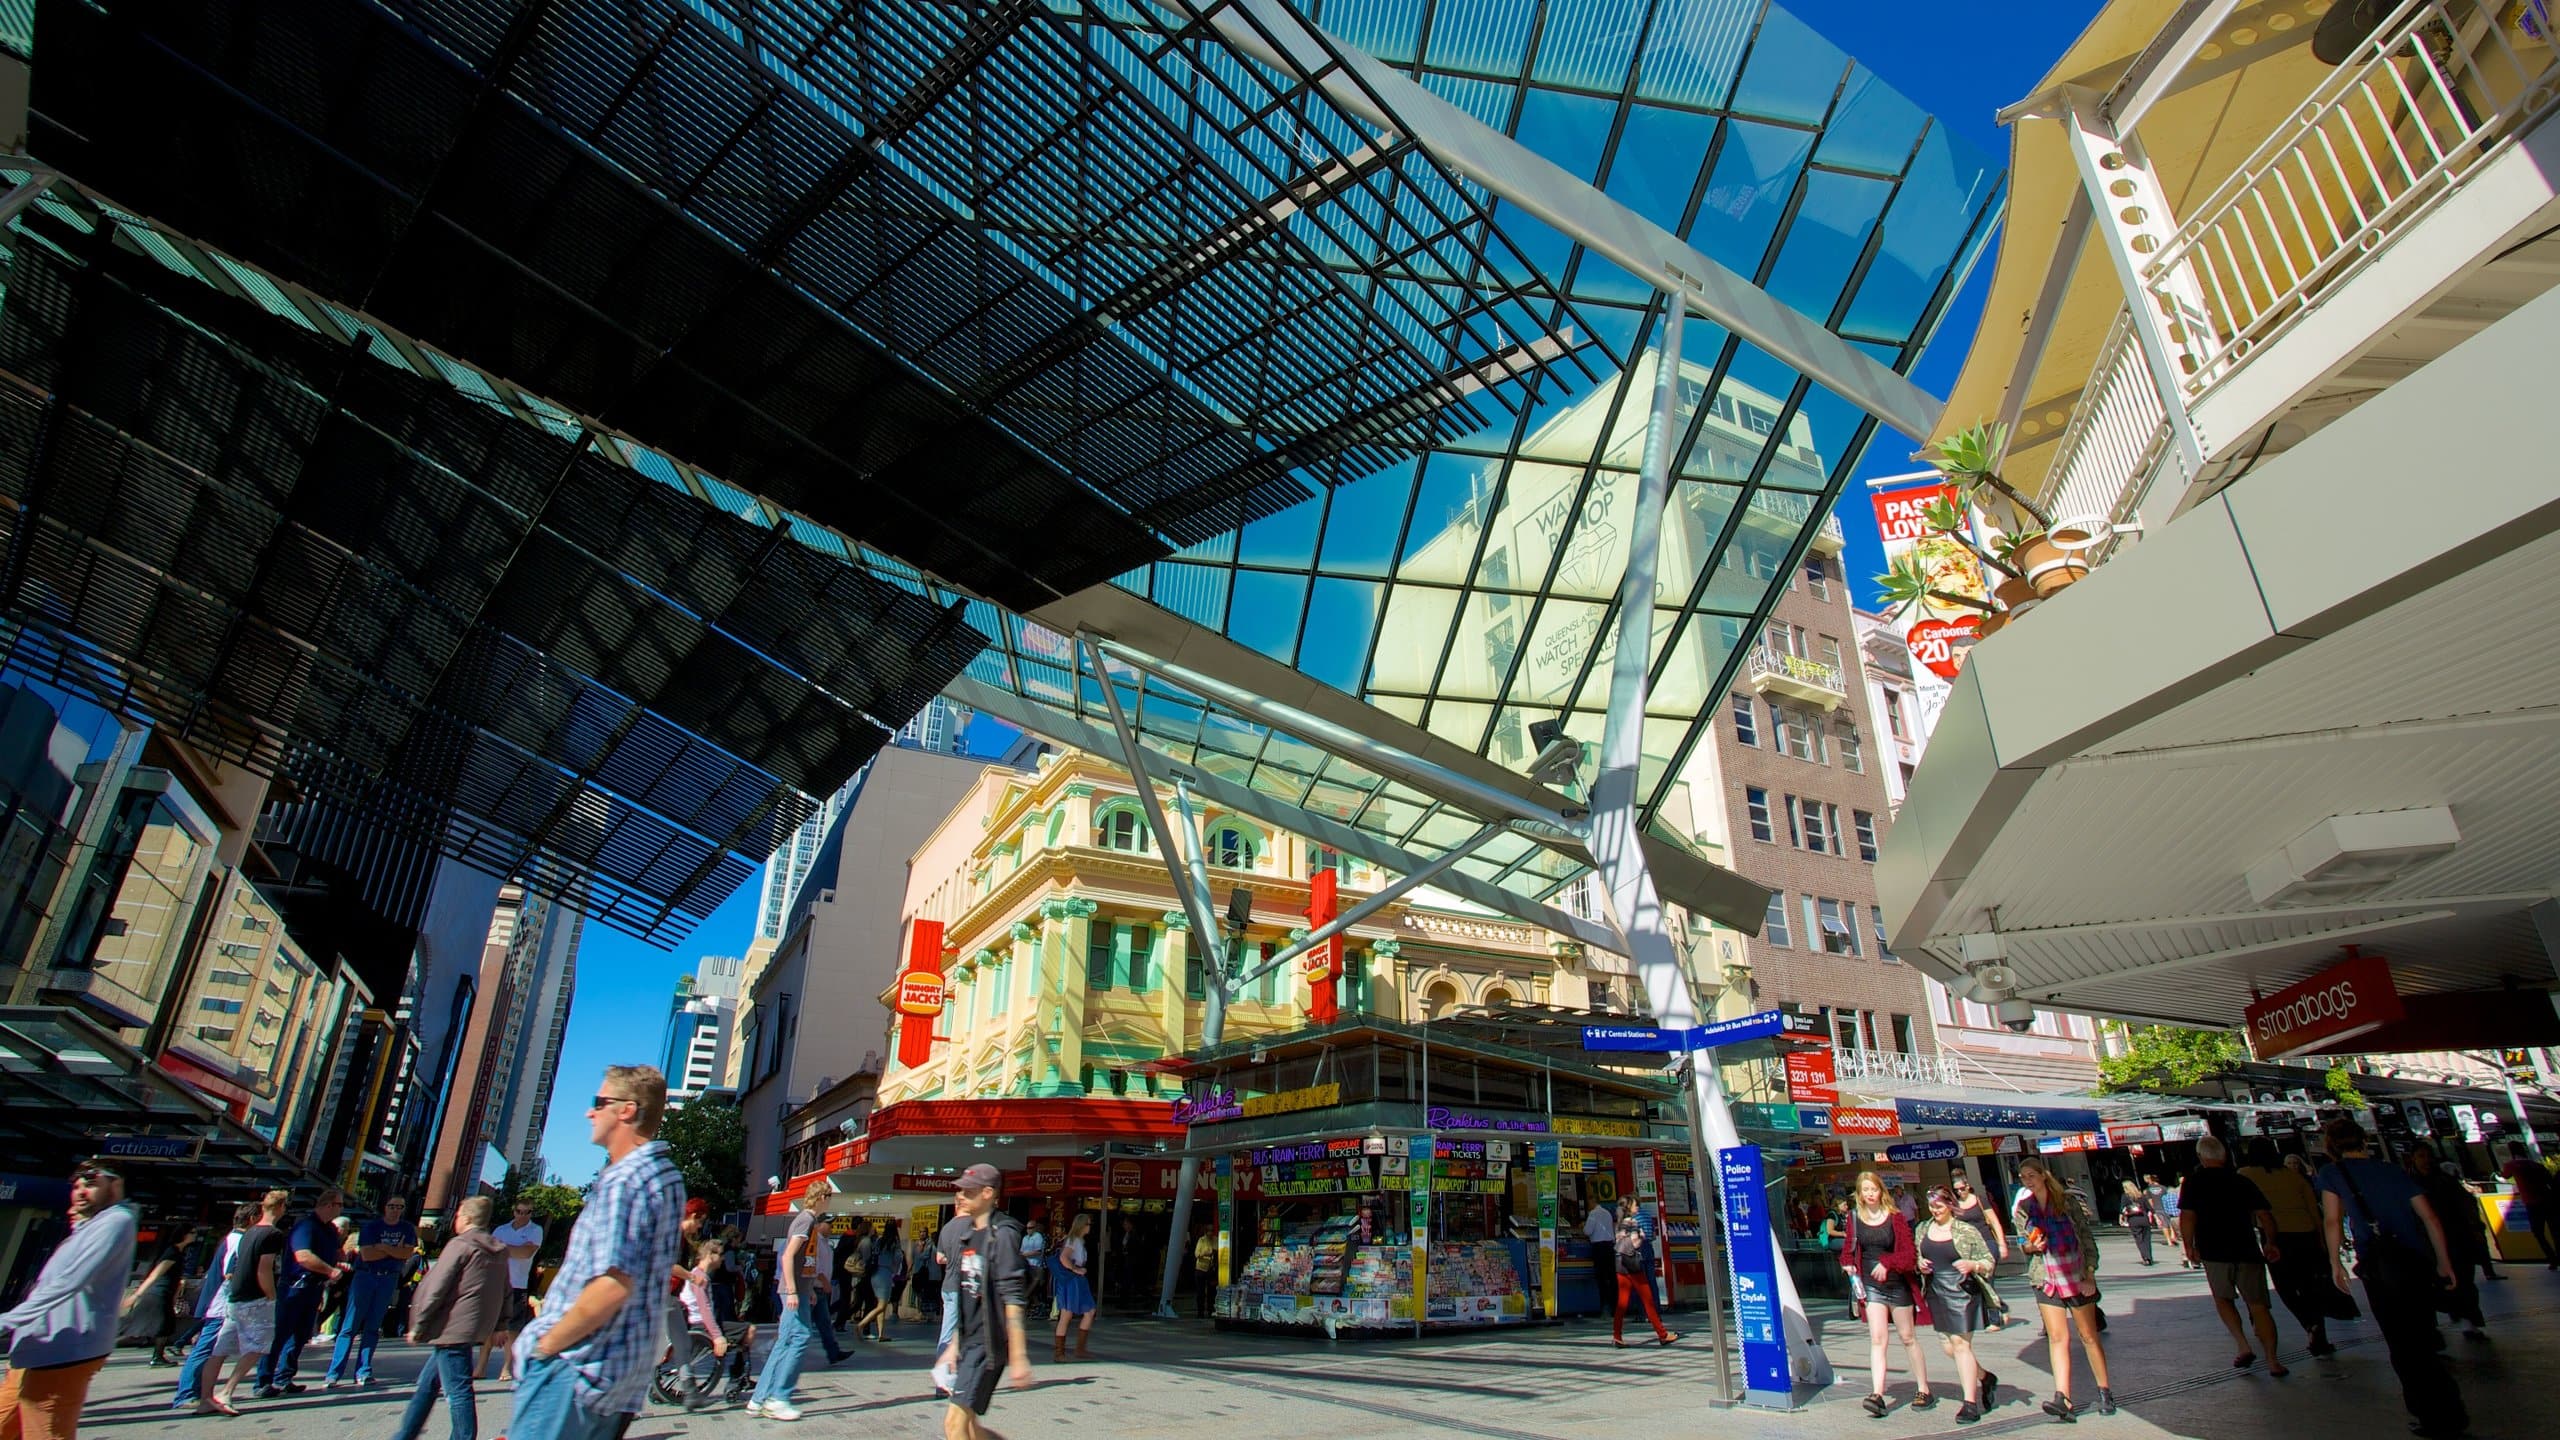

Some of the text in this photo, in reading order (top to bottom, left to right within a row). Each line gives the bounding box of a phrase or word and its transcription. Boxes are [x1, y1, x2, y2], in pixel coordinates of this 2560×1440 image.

[1536, 634, 1578, 670] WATCH
[1909, 638, 1950, 664] $20
[1307, 944, 1328, 960] HUNGRY
[904, 983, 941, 994] HUNGRY
[904, 992, 941, 1005] JACK'S
[2257, 981, 2357, 1041] strandbags
[1705, 1025, 1726, 1035] Adelaide
[1726, 1023, 1732, 1031] St
[1741, 1018, 1753, 1027] Mall
[1790, 1070, 1826, 1084] 3231 1311
[1428, 1107, 1488, 1128] Rankins
[1526, 1120, 1546, 1132] mall
[1916, 1104, 1958, 1120] WALLACE
[1963, 1107, 1994, 1122] BISHOP
[1837, 1112, 1892, 1132] exchange
[110, 1142, 178, 1156] citibank
[1328, 1139, 1361, 1150] DISCOUNT
[1461, 1143, 1485, 1153] FERRY
[1253, 1143, 1327, 1165] BUS TRAIN FERRY
[1328, 1147, 1361, 1158] TICKETS
[1451, 1150, 1481, 1160] TICKETS
[1890, 1150, 1926, 1161] WALLACE
[1928, 1148, 1957, 1159] BISHOP
[1725, 1164, 1751, 1175] Police
[1288, 1179, 1306, 1193] LOTTO
[1347, 1176, 1375, 1190] MILLION
[1480, 1179, 1505, 1193] MILLION
[1741, 1293, 1767, 1303] CitySafe
